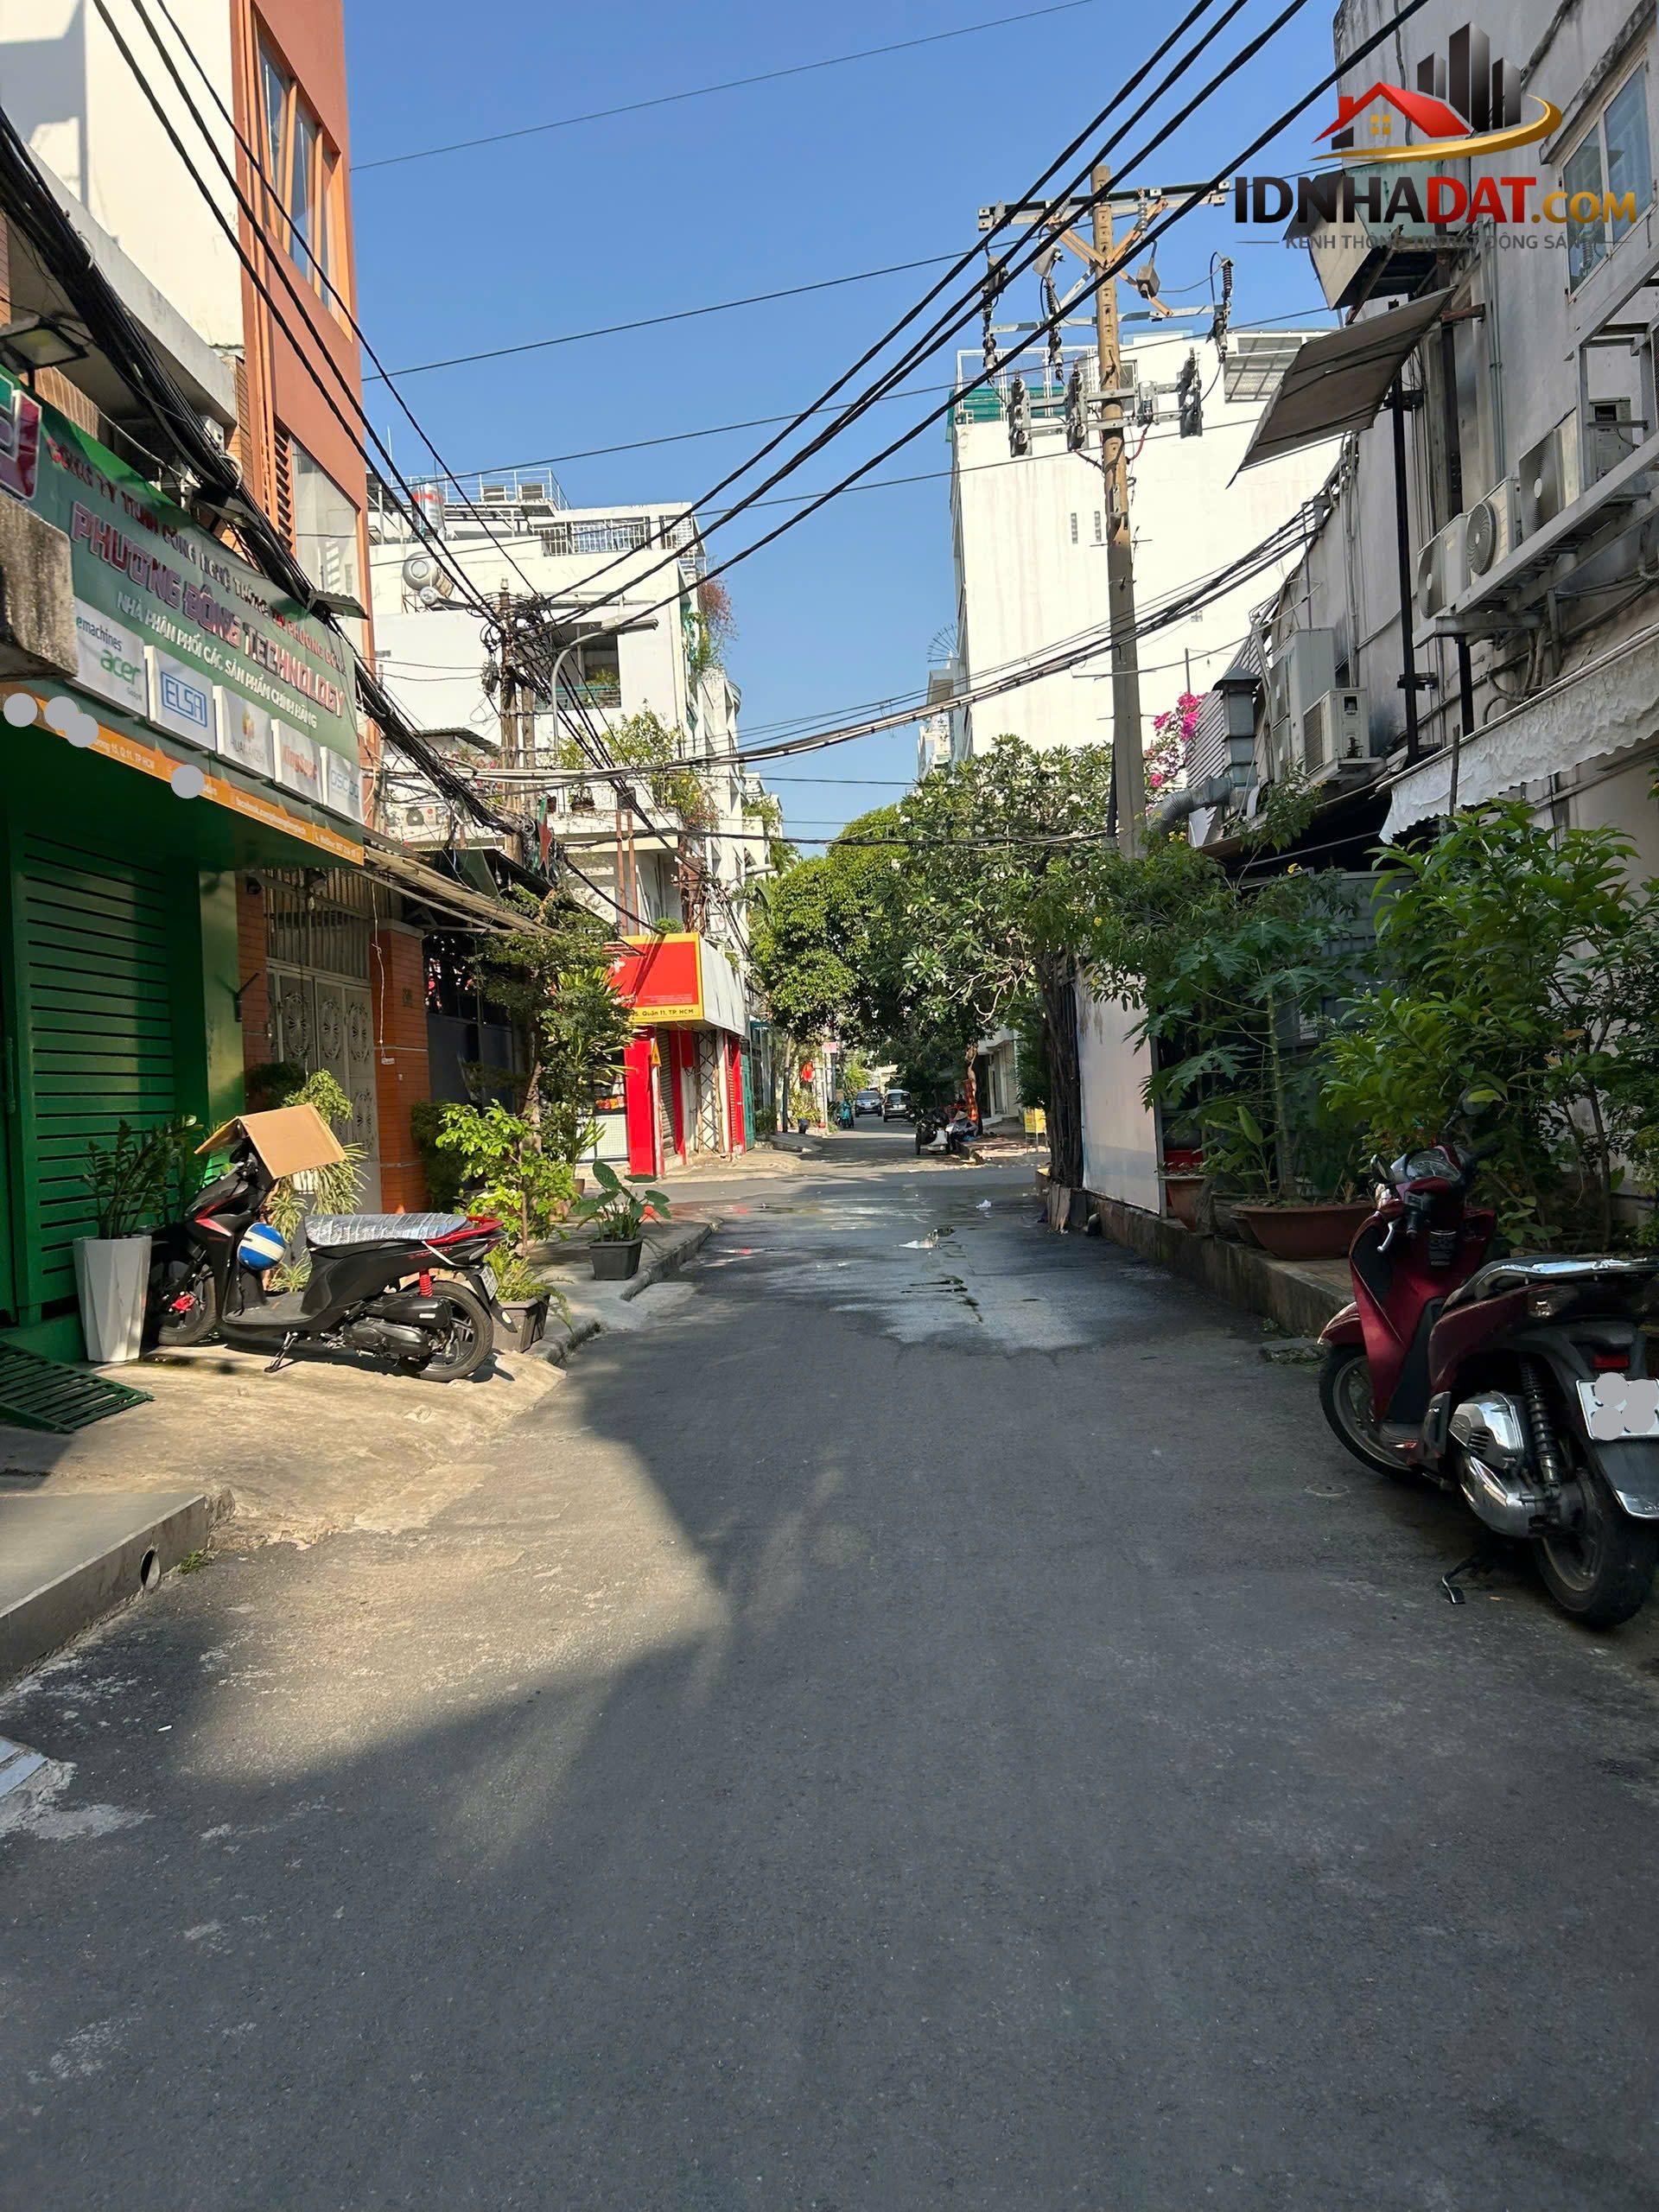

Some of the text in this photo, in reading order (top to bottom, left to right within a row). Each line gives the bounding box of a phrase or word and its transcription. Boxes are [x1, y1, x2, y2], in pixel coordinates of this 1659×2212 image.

[71, 499, 346, 719] PHƯƠNG ĐÔNG TECHNOLOGY
[76, 616, 122, 652] emachines
[99, 648, 141, 686] acer
[117, 590, 144, 623] NHÀ
[145, 608, 178, 643] PHÂN
[176, 627, 204, 659] PHỐI
[225, 658, 245, 683] SẢN
[245, 673, 271, 702] PHẨM
[270, 689, 295, 716] CHÍNH
[295, 704, 318, 728] HÀNG
[165, 678, 204, 722] ELSA
